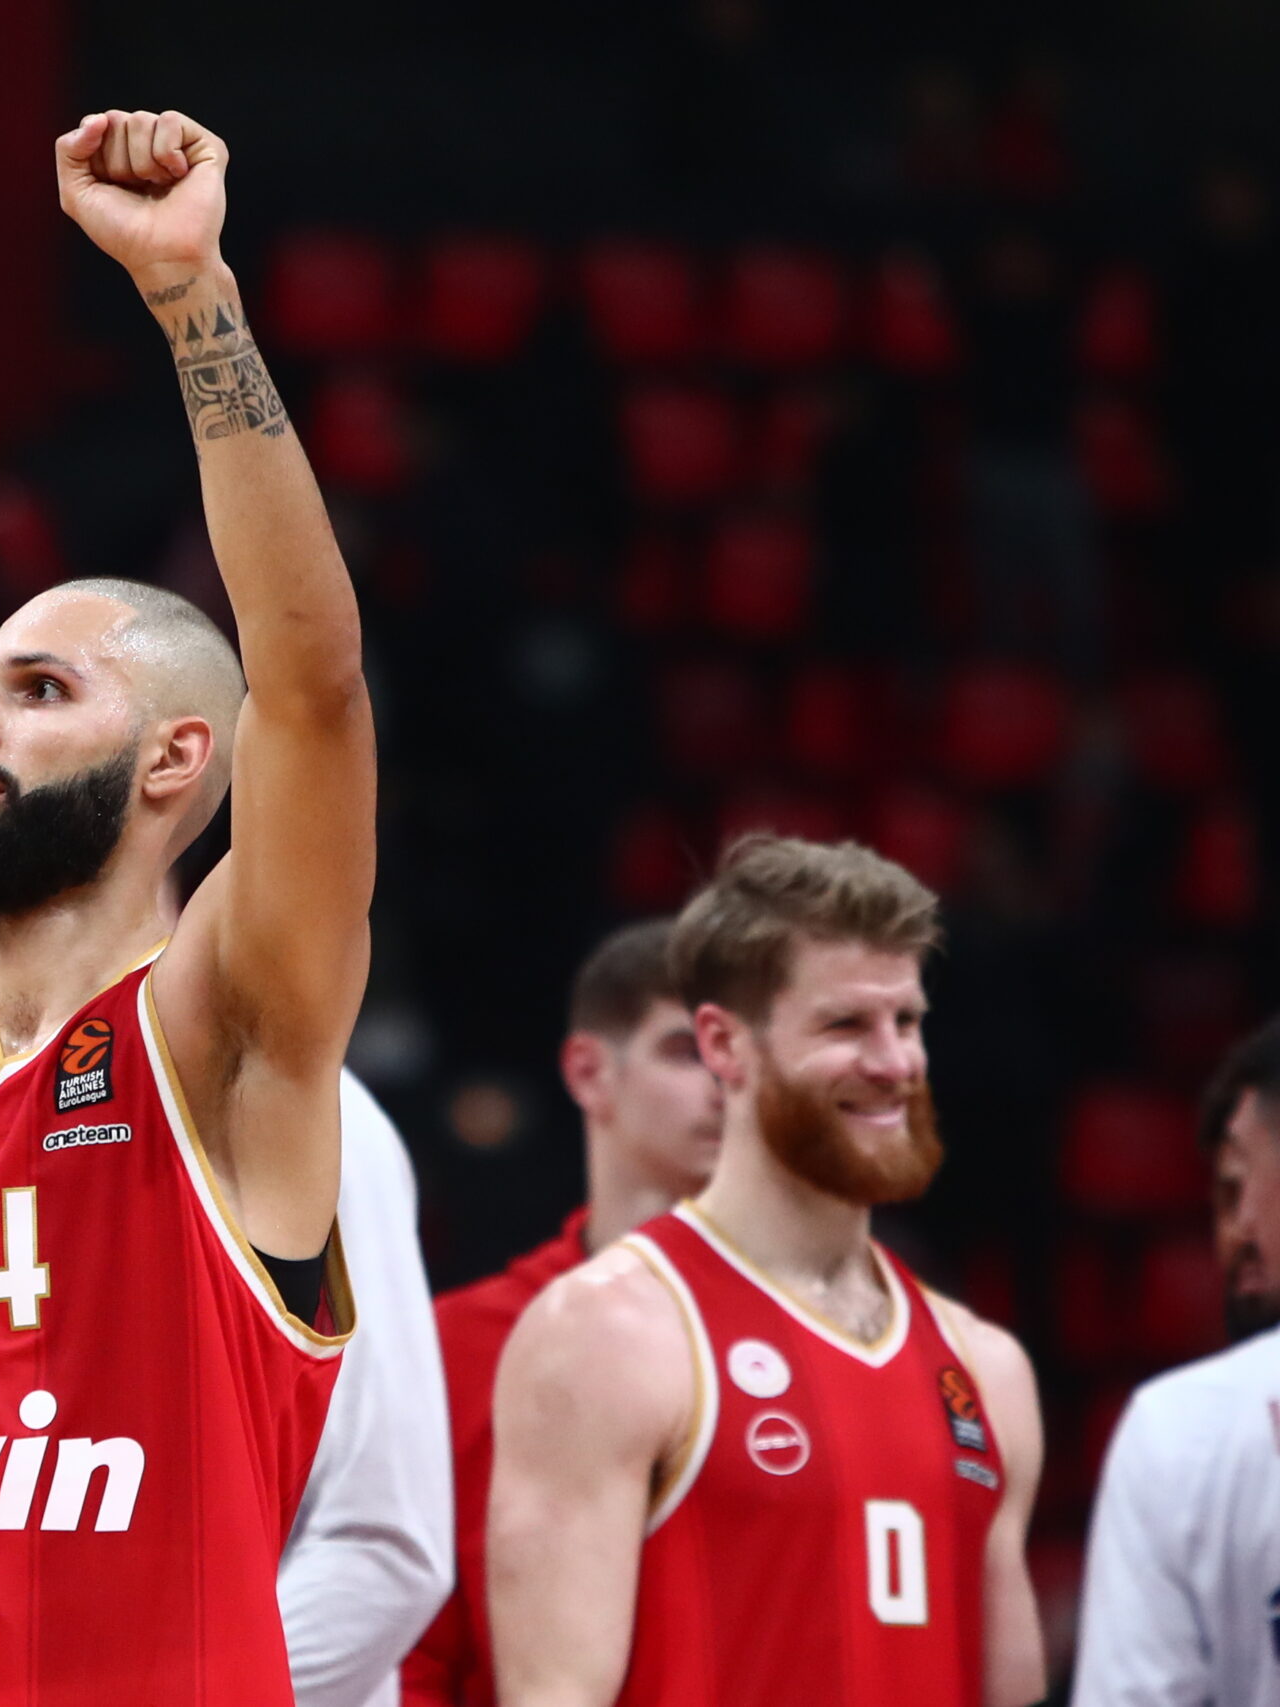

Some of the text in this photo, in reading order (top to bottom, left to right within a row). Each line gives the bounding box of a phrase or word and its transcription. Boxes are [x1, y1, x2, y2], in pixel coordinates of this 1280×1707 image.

[59, 1079, 105, 1100] AIRLINES
[60, 1069, 104, 1089] TURKISH
[58, 1090, 107, 1110] EuroLeague
[44, 1125, 130, 1150] oneteam
[864, 1498, 929, 1627] 0
